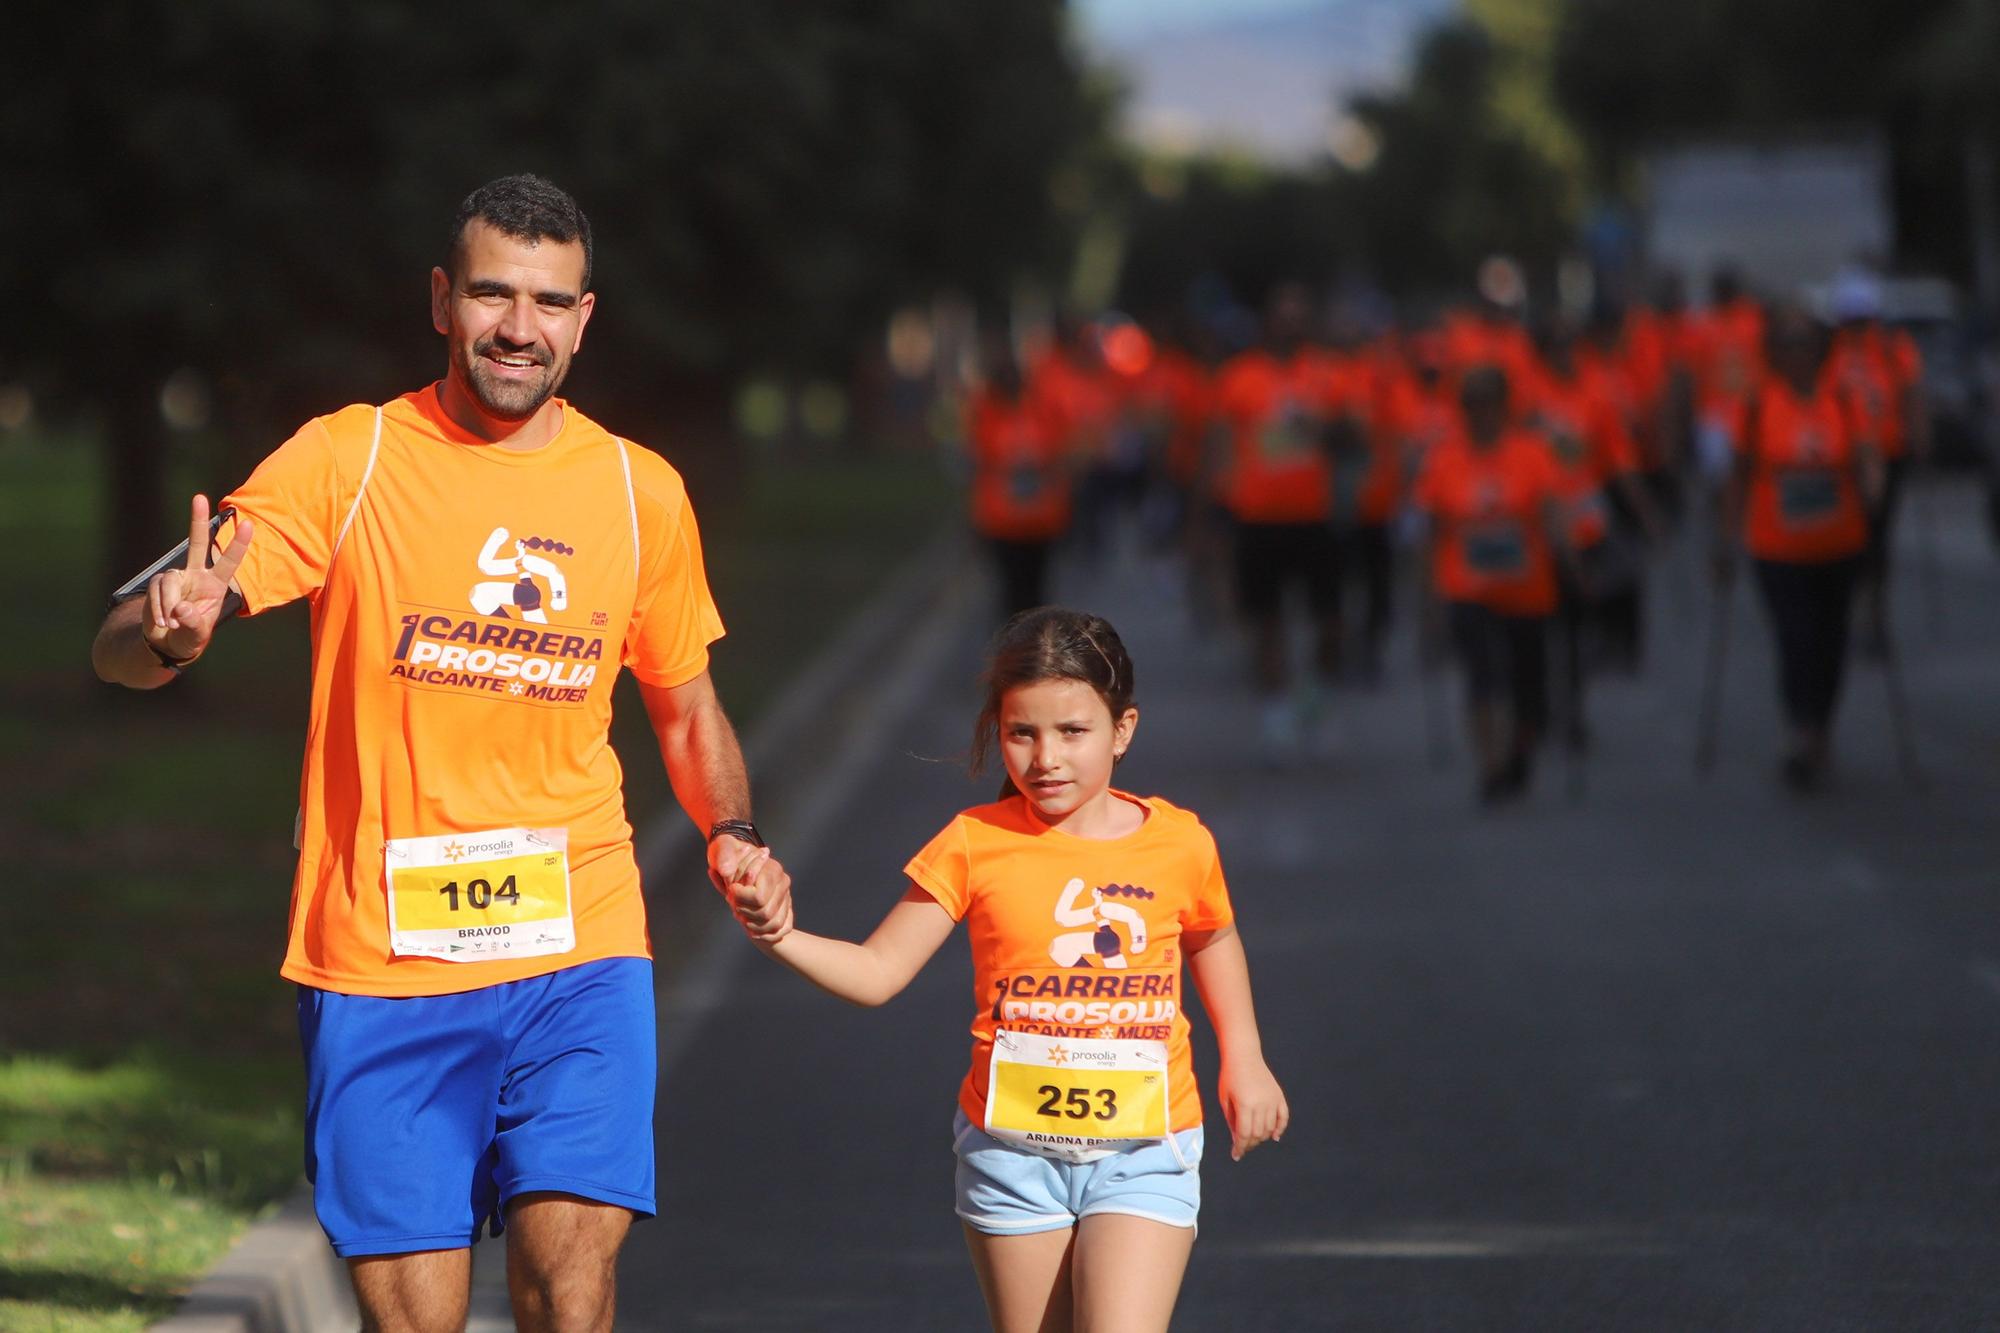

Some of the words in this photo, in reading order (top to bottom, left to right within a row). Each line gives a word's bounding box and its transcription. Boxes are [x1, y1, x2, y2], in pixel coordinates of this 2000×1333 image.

[420, 616, 602, 660] CARRERA
[409, 641, 597, 687] PROSOLIA
[390, 665, 506, 692] ALICANTE
[525, 685, 588, 702] MUJER
[468, 840, 513, 856] prosolia
[439, 875, 520, 911] 104
[458, 926, 511, 938] BRAVOD
[1011, 974, 1174, 998] CARRERA
[1004, 1000, 1176, 1025] PROSOLIA
[1116, 1025, 1171, 1039] MUJER
[1071, 1050, 1117, 1062] prosolia
[1036, 1085, 1118, 1121] 253
[1026, 1132, 1083, 1145] ARIADNA
